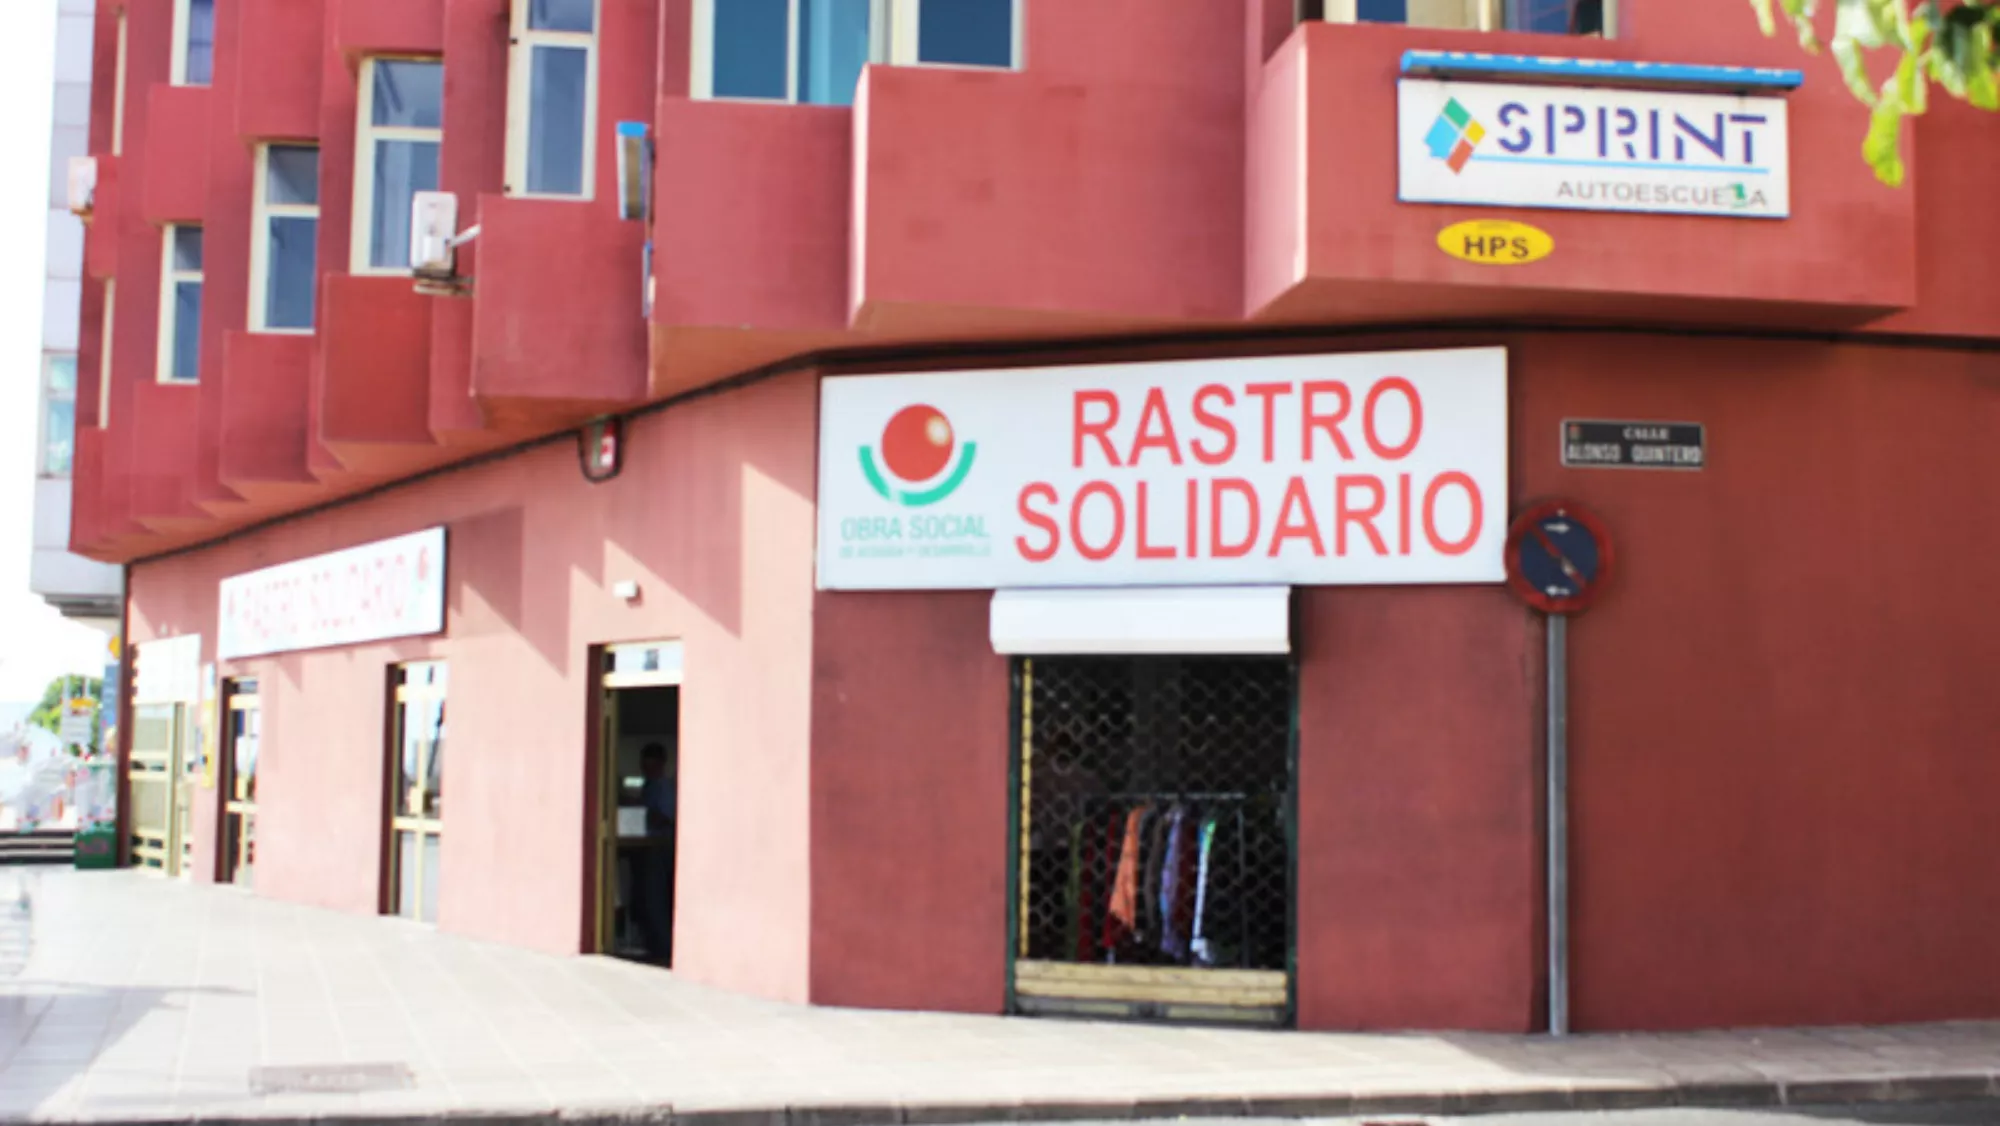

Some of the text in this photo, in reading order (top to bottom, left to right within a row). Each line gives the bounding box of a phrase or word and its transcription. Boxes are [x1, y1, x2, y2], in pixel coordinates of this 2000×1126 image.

[1497, 101, 1767, 164] SPRINT
[1463, 235, 1530, 259] HPS
[1072, 376, 1423, 468] RASTRO
[840, 513, 990, 541] OBRA SOCIAL
[1015, 471, 1484, 561] SOLIDARIO
